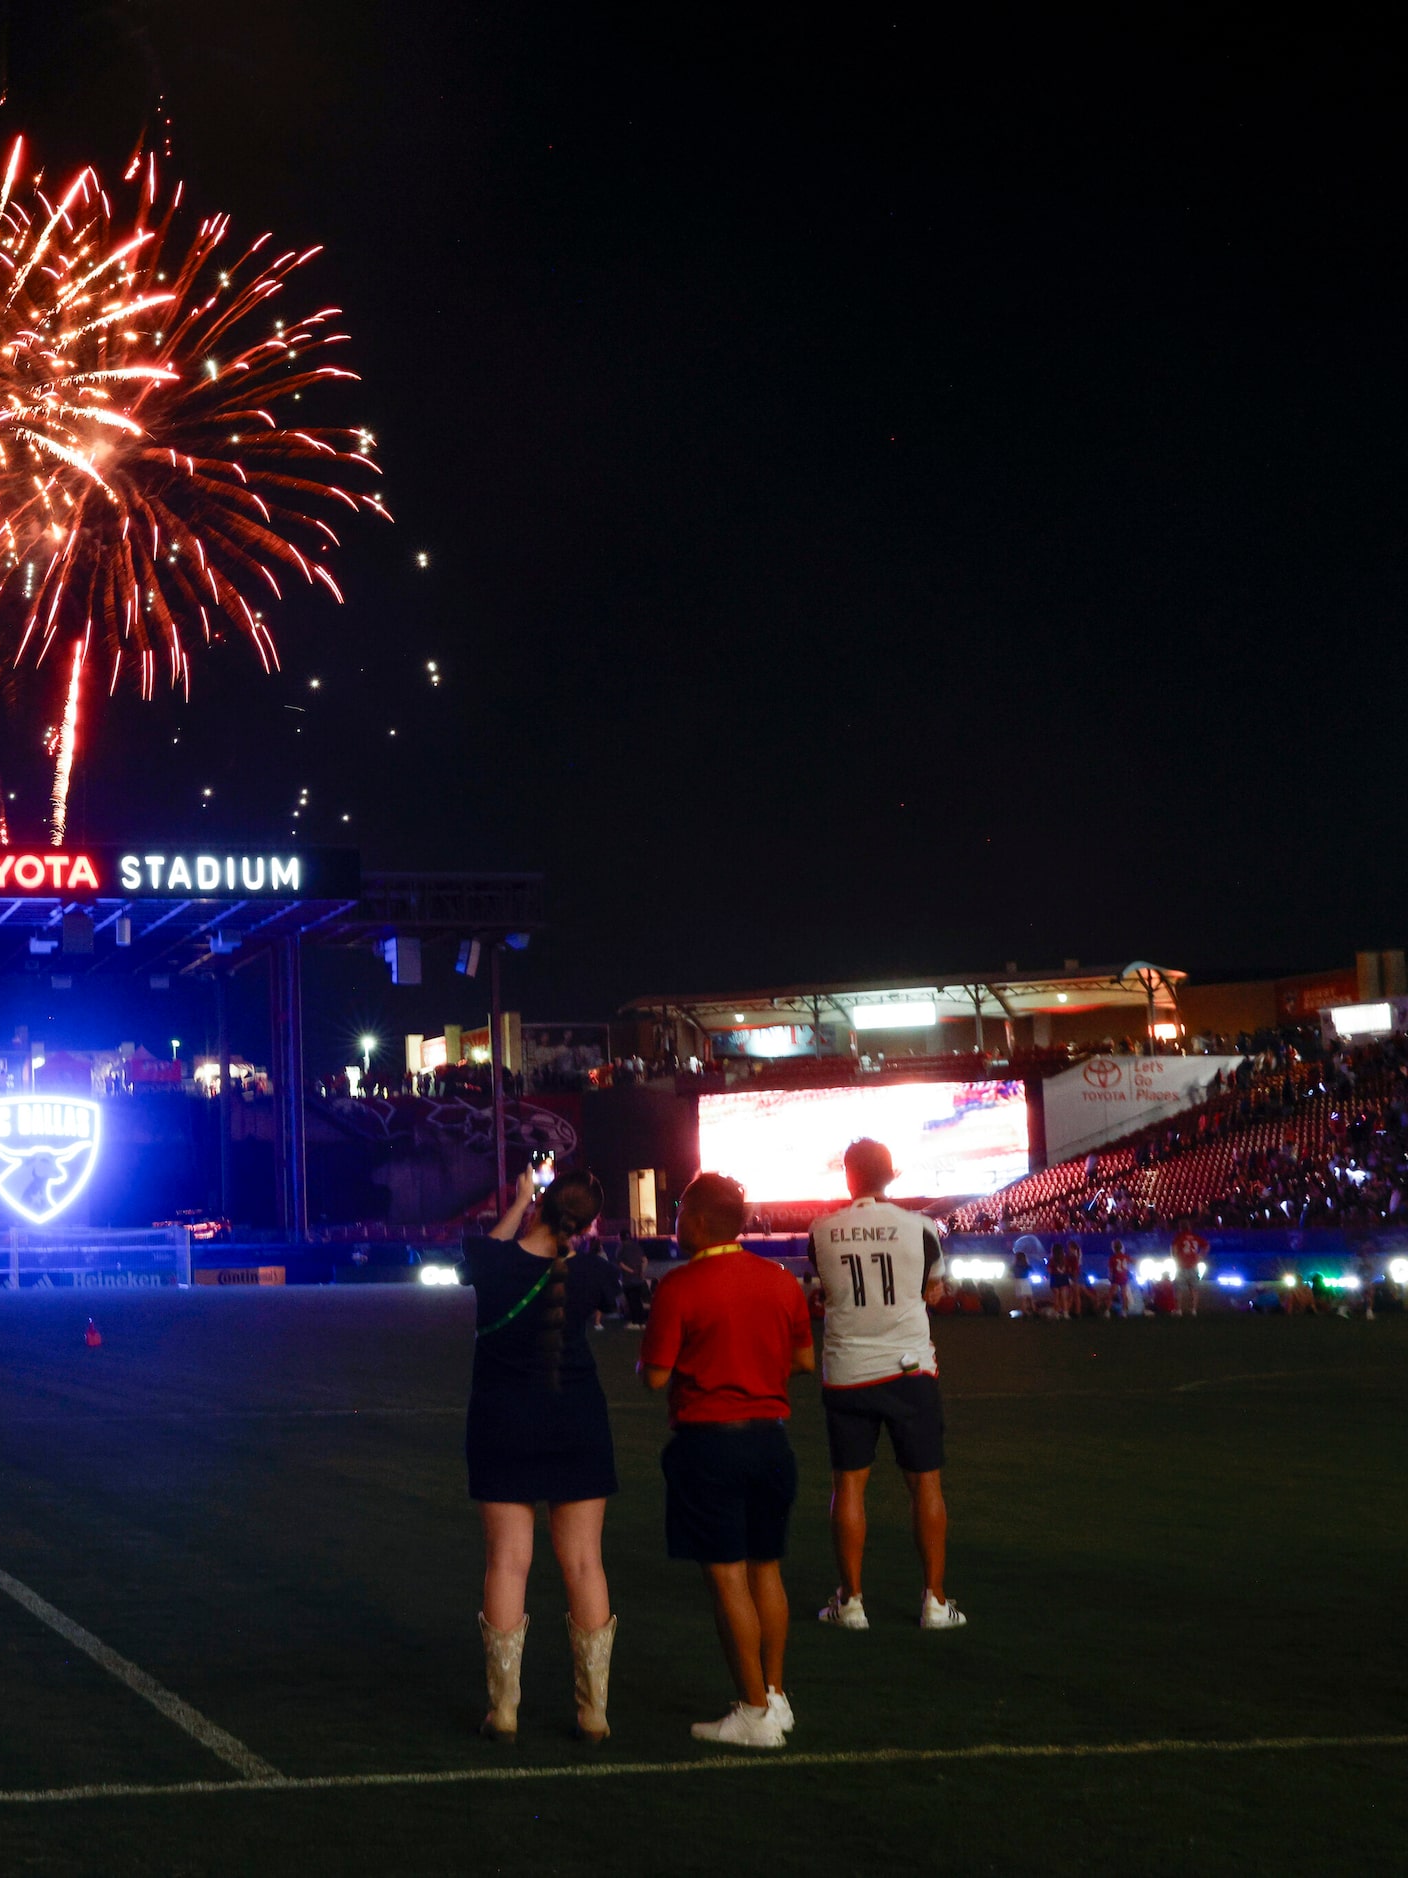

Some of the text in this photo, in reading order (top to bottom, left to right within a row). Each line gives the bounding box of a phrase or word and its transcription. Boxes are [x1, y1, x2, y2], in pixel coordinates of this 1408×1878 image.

[119, 855, 301, 891] STADIUM
[1134, 1060, 1164, 1073] Let's
[1135, 1074, 1152, 1087] Go
[1082, 1091, 1127, 1102] TOYOTA
[1136, 1089, 1179, 1101] Places
[17, 1102, 91, 1138] DALLAS
[830, 1226, 900, 1244] ELENEZ
[840, 1252, 896, 1307] 11
